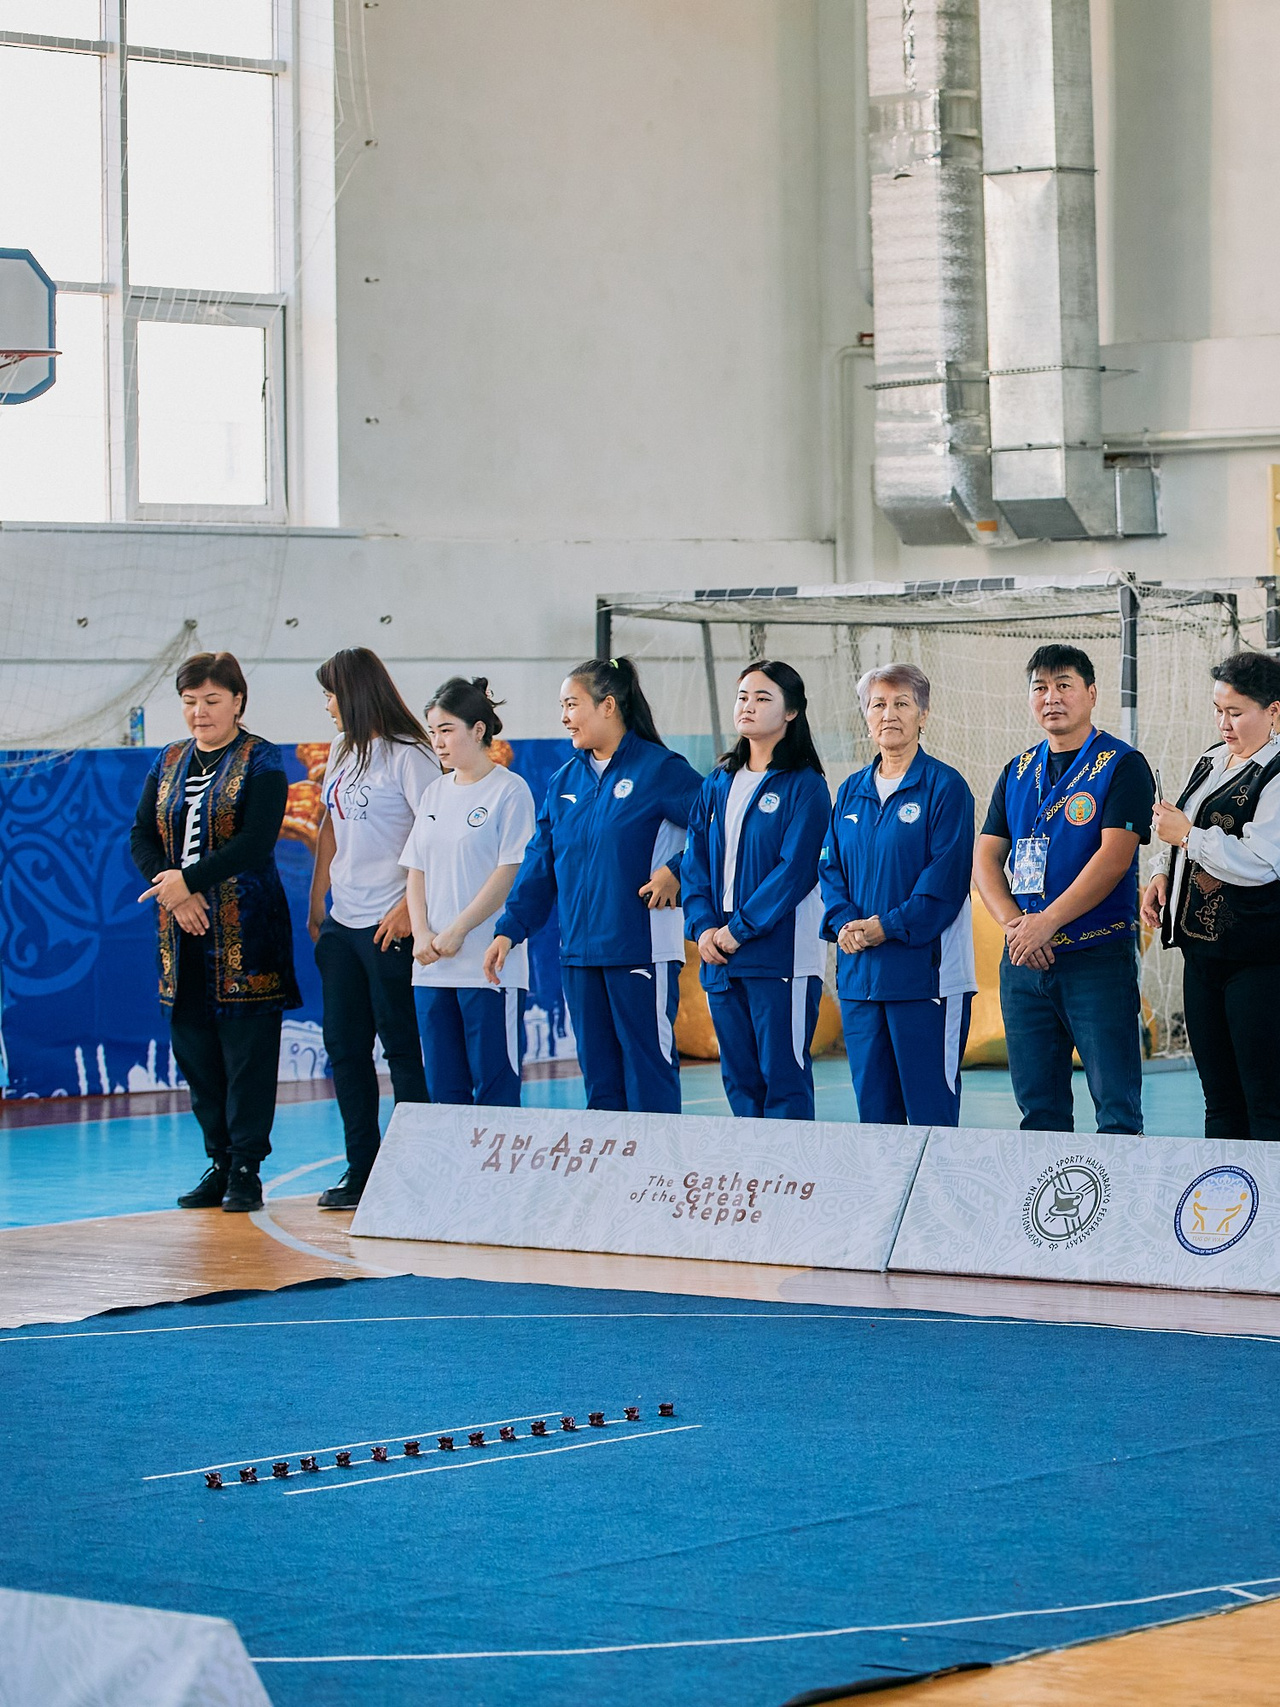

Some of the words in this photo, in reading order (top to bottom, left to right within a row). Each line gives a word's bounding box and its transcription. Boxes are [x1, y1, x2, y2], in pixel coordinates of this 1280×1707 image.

[470, 1128, 533, 1150] Ұлы
[550, 1132, 638, 1157] Дала
[1055, 1155, 1084, 1168] SPORTY
[629, 1189, 647, 1203] of
[652, 1190, 677, 1203] the
[686, 1187, 758, 1208] Great
[649, 1175, 674, 1187] The
[683, 1171, 816, 1200] Gathering
[672, 1201, 762, 1226] Steppe
